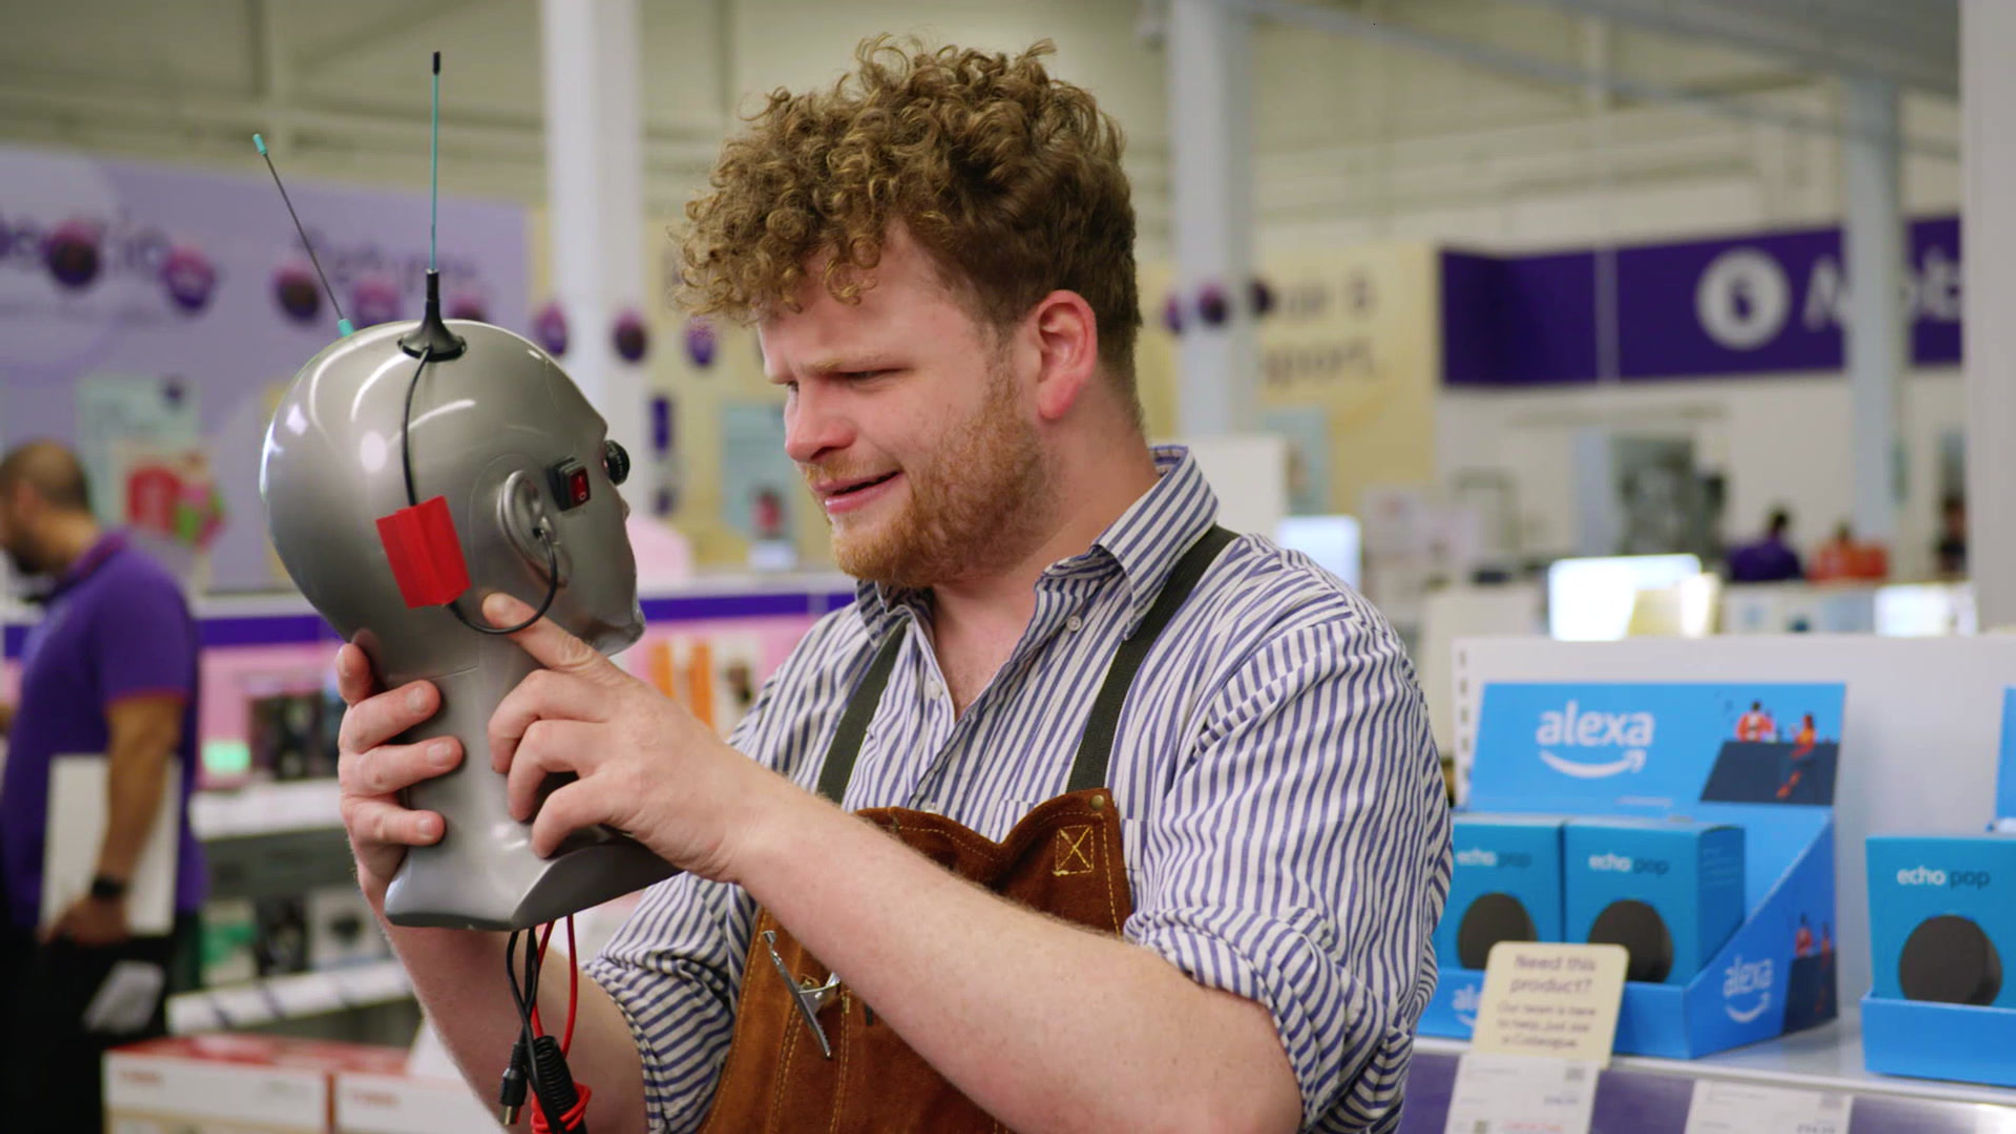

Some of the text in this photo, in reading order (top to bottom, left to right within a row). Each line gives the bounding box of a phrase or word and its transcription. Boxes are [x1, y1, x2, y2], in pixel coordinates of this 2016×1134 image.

[1535, 698, 1656, 747] alexa
[1456, 847, 1497, 867] echo
[1588, 853, 1632, 872] echo
[1896, 864, 1991, 891] echo pop
[1515, 954, 1562, 970] Need
[1509, 977, 1593, 994] product?
[1723, 953, 1773, 998] alexa
